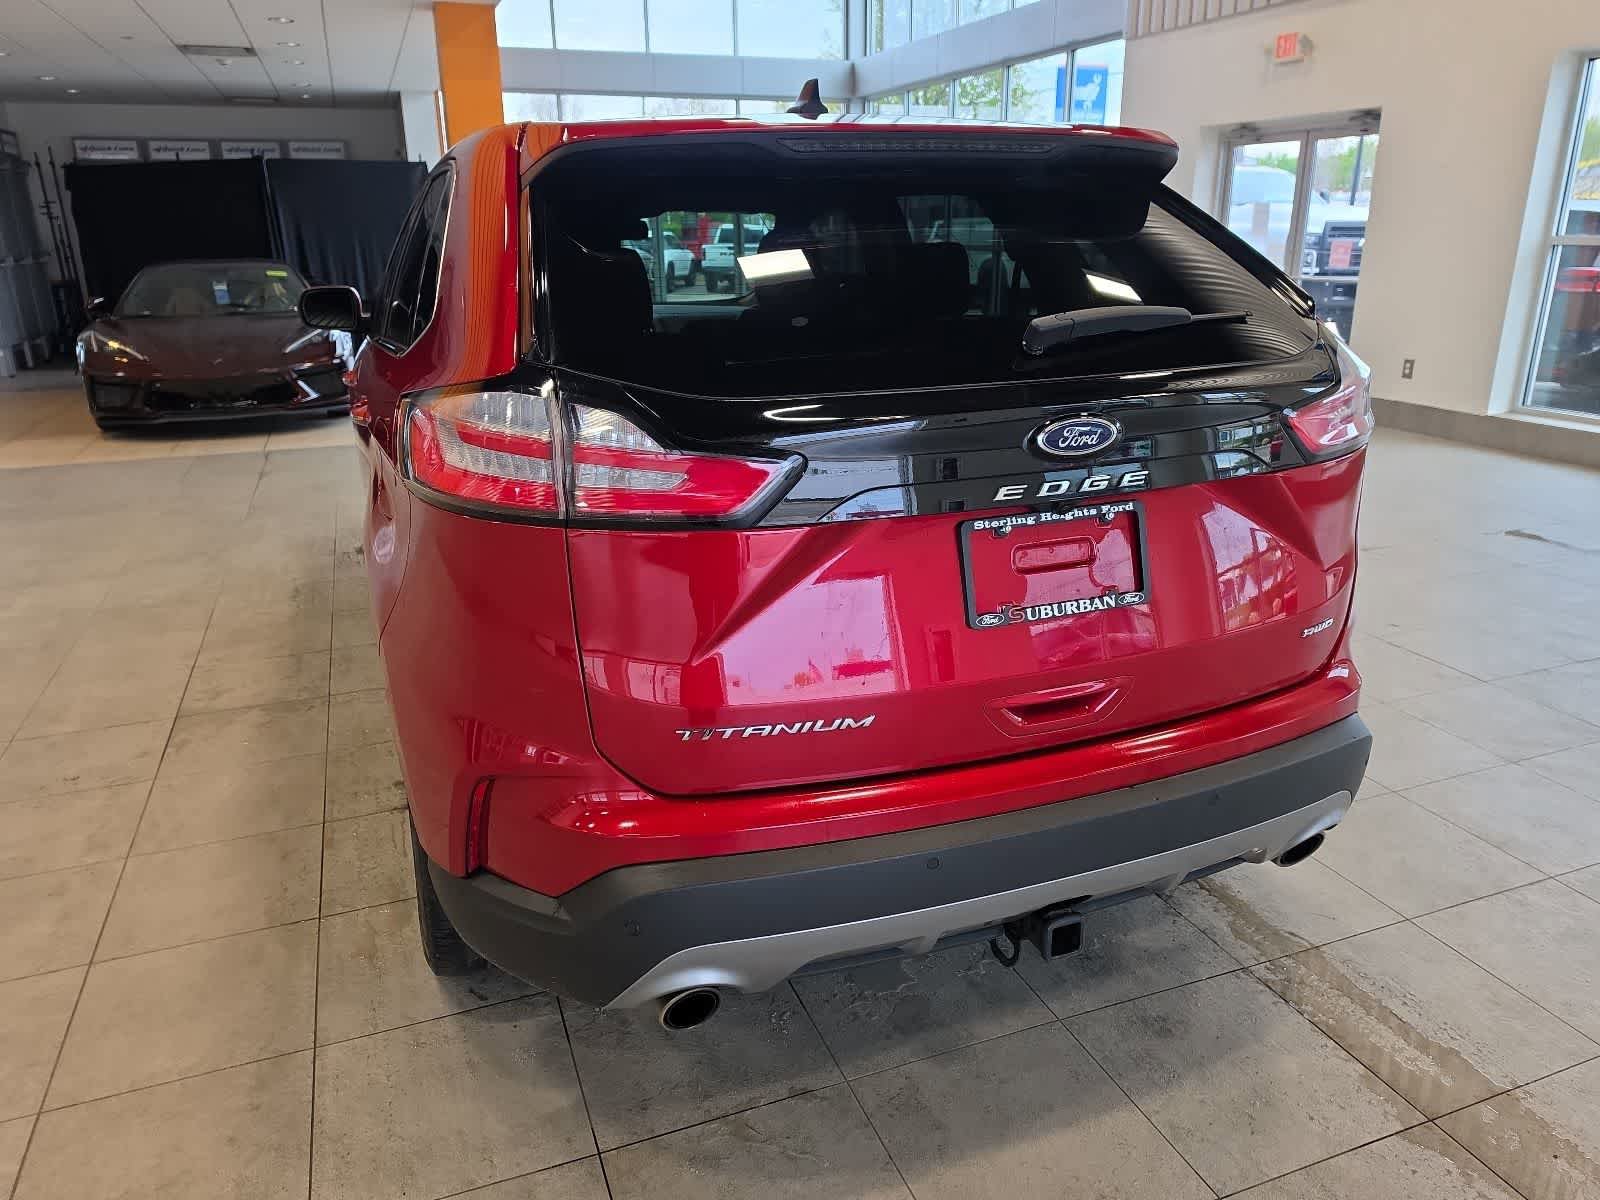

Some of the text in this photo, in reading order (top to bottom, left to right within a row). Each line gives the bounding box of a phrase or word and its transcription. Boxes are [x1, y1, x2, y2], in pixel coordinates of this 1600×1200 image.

[1058, 425, 1101, 448] Ford
[993, 471, 1149, 501] EDGE
[973, 515, 1037, 531] Sterling
[1101, 502, 1134, 515] Ford
[1008, 595, 1116, 623] SUBURBAN
[1301, 617, 1334, 638] AWD
[675, 714, 876, 741] TITANIUM
